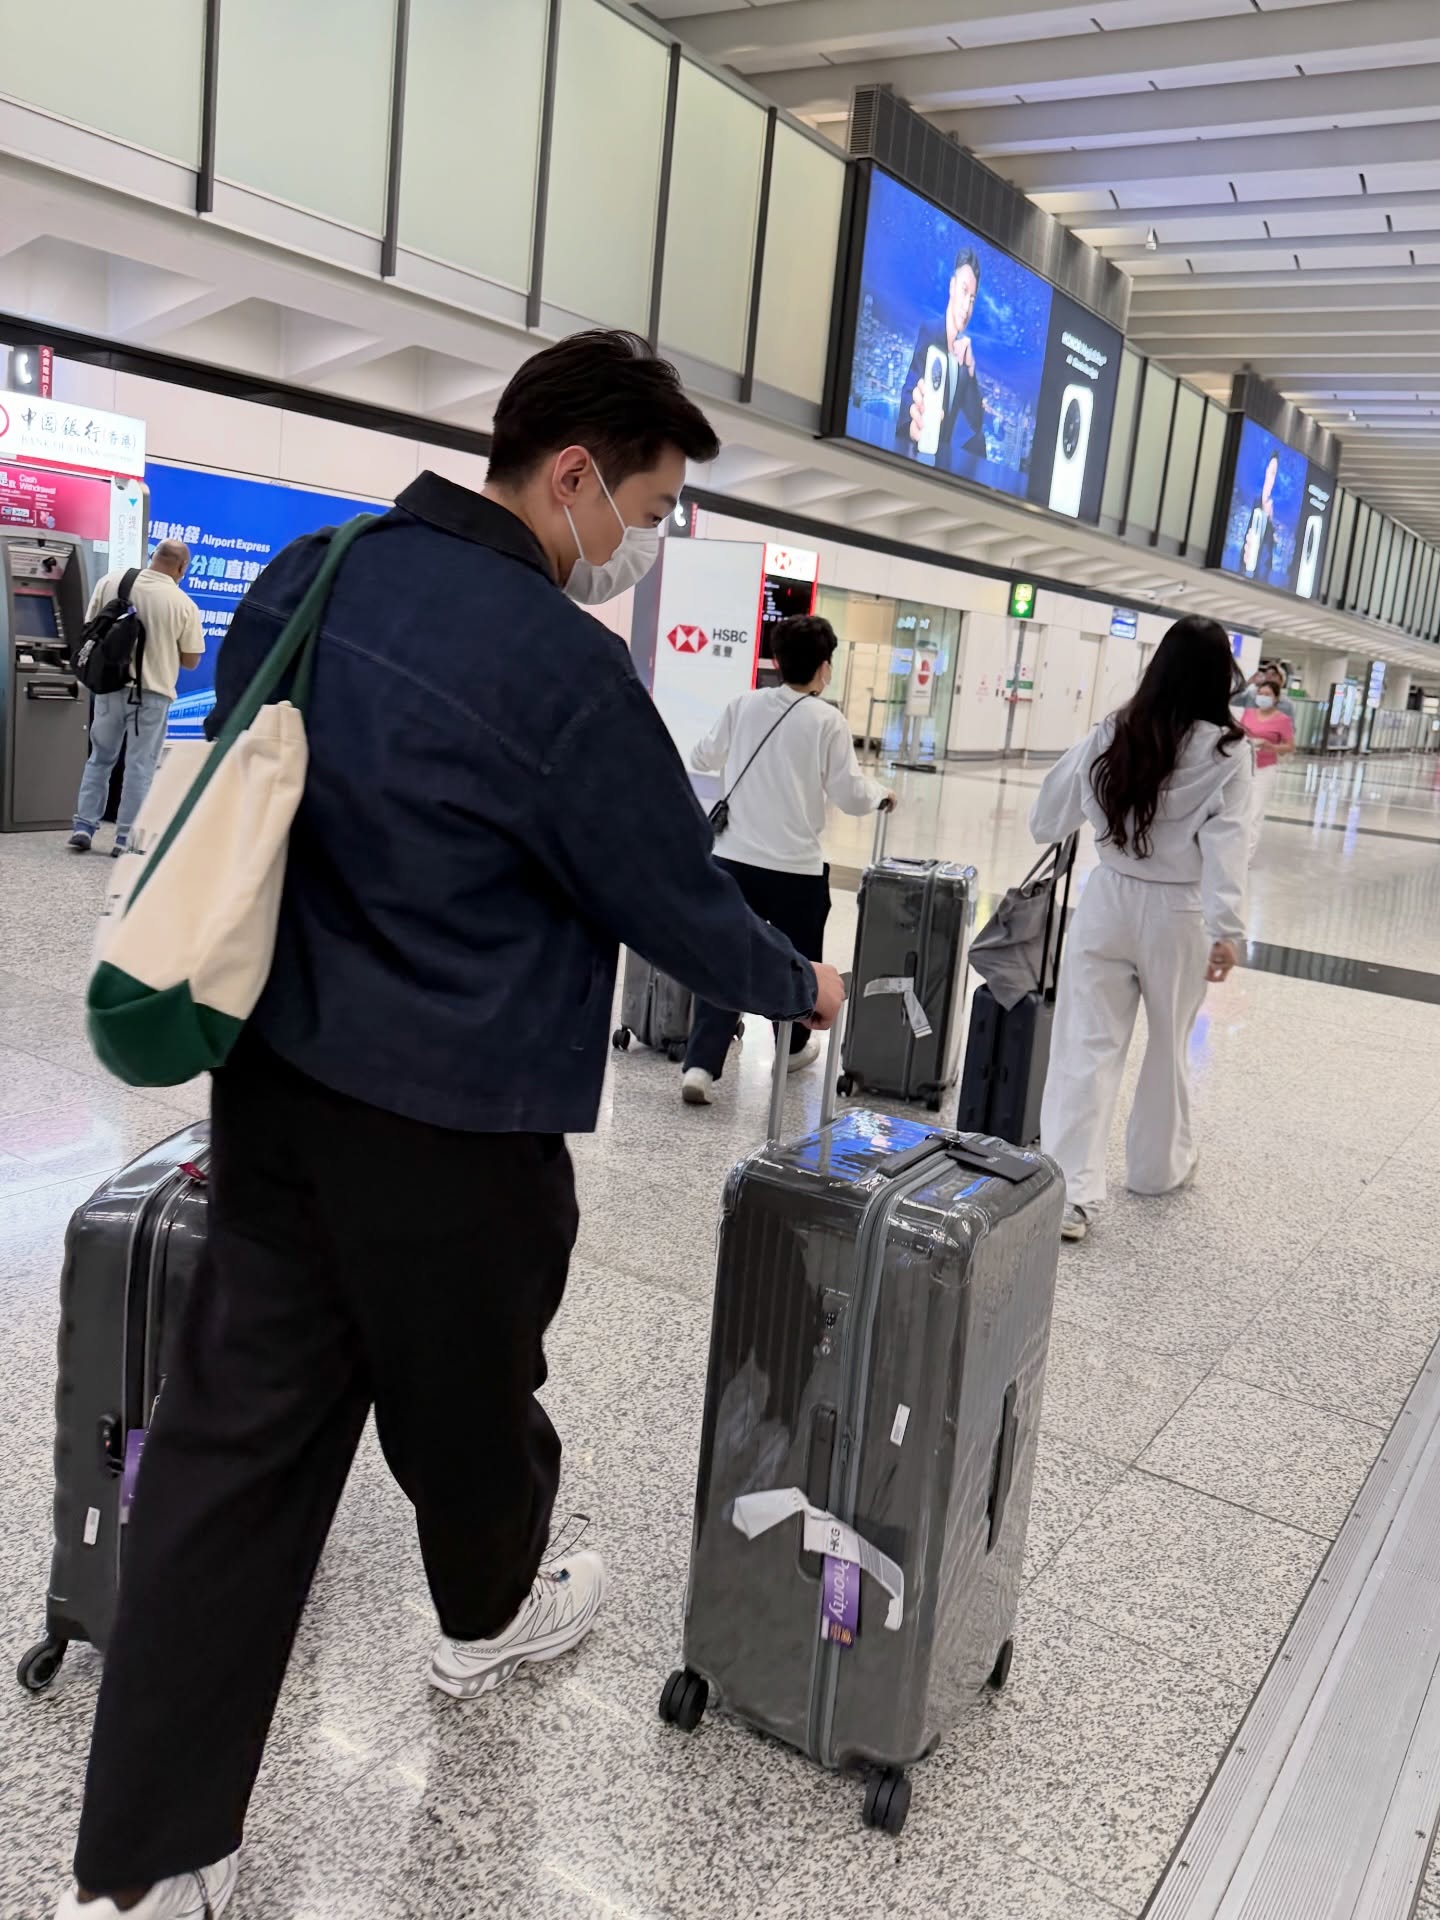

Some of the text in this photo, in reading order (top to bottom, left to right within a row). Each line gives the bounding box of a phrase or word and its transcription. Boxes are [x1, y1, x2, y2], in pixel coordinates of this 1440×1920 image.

[19, 473, 38, 484] Cash
[19, 481, 56, 495] Withdrawal
[201, 533, 271, 553] Airport Express
[188, 576, 208, 590] The
[208, 579, 243, 593] fastest
[712, 628, 748, 644] HSBC
[830, 1527, 841, 1553] HKG
